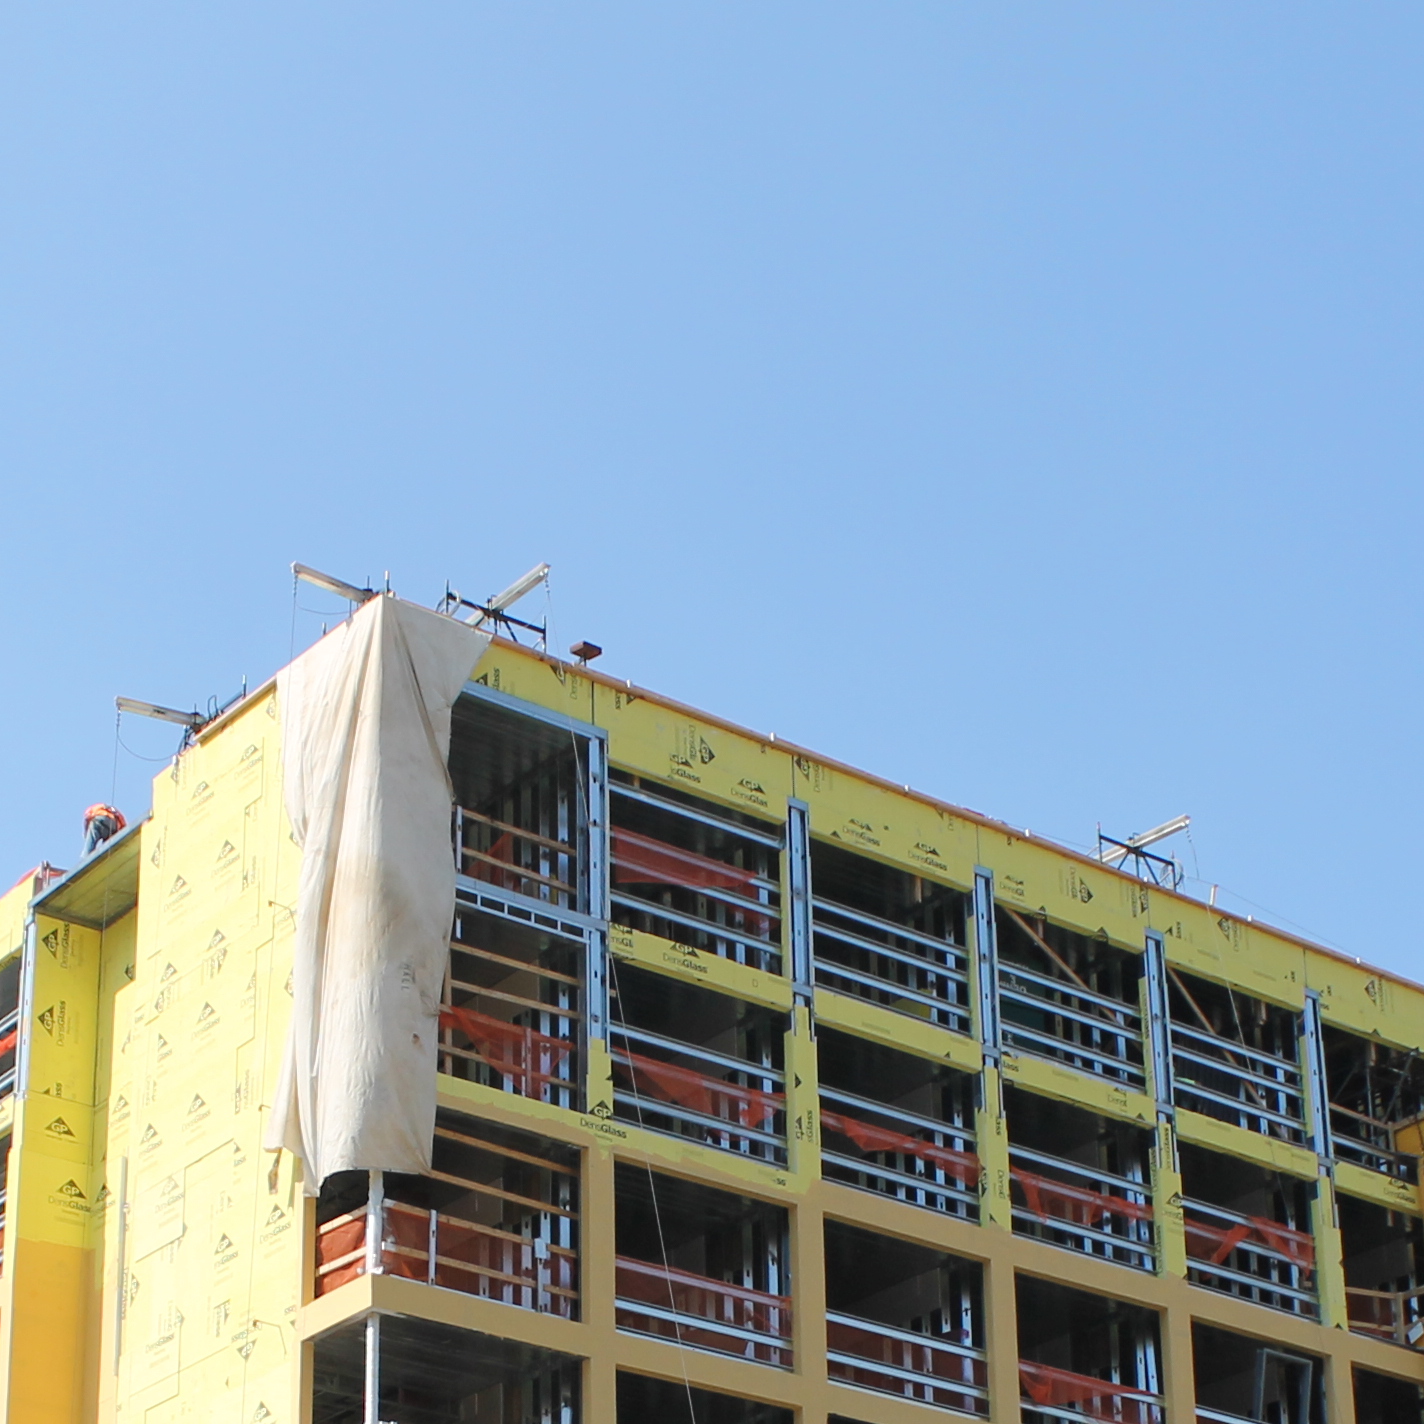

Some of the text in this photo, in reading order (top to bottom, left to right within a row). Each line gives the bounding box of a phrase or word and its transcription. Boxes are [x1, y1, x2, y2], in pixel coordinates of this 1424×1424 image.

[47, 934, 56, 952] GP
[60, 923, 70, 969] DensGlass
[662, 952, 708, 974] DensGlass
[43, 1012, 52, 1030] GP
[56, 1000, 66, 1047] DensGlass
[594, 1106, 611, 1119] GP
[51, 1122, 68, 1133] GP
[580, 1117, 627, 1139] DensGlass
[62, 1185, 80, 1196] GP
[48, 1195, 91, 1213] DensGlass
